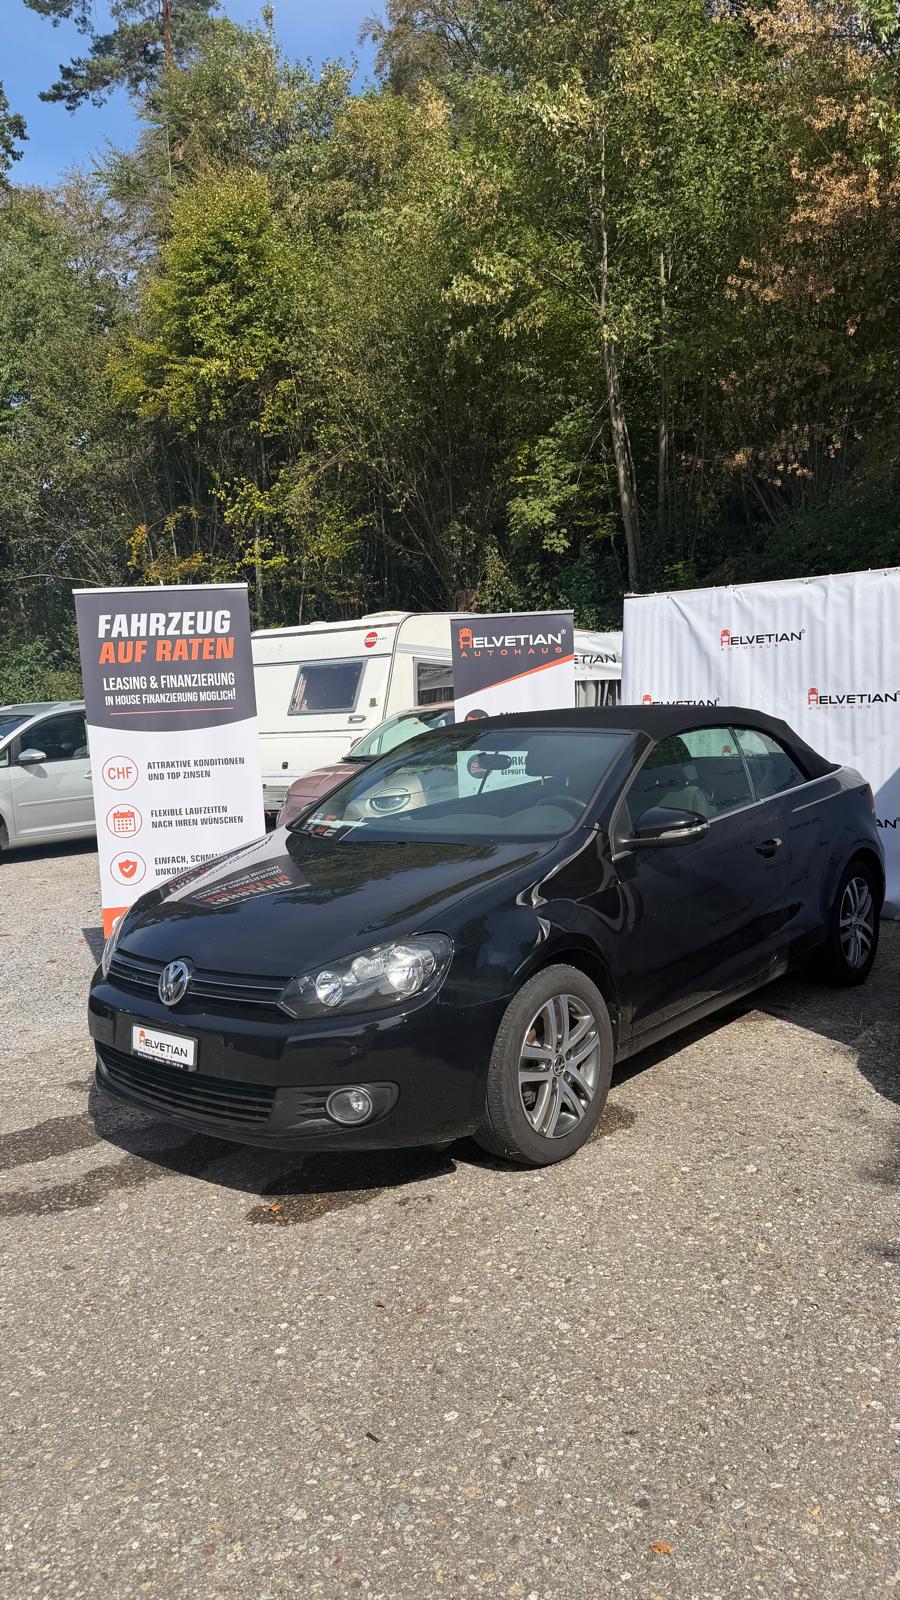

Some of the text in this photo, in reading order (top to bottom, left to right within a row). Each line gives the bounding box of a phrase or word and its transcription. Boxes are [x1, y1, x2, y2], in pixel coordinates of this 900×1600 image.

[98, 610, 231, 638] FAHRZEUG
[99, 636, 235, 664] AUF RATEN
[460, 646, 563, 657] AUTOHAUS
[103, 672, 235, 691] LEASING & FINANZIERUNG
[105, 695, 114, 706] IN
[115, 694, 141, 706] HOUSE
[142, 691, 198, 704] FINANZIERUNG
[147, 757, 245, 770] ATTRAKTIVE KONDITIONEN
[107, 766, 133, 780] CHF
[148, 770, 211, 781] UND TOP ZINSEN
[150, 805, 228, 817] FLEXIBLE LAUFZEITEN
[151, 815, 244, 829] NACH IHREN WÜNSCHEN
[154, 855, 189, 865] EINFACH,
[139, 1030, 188, 1058] HELVETIAN
